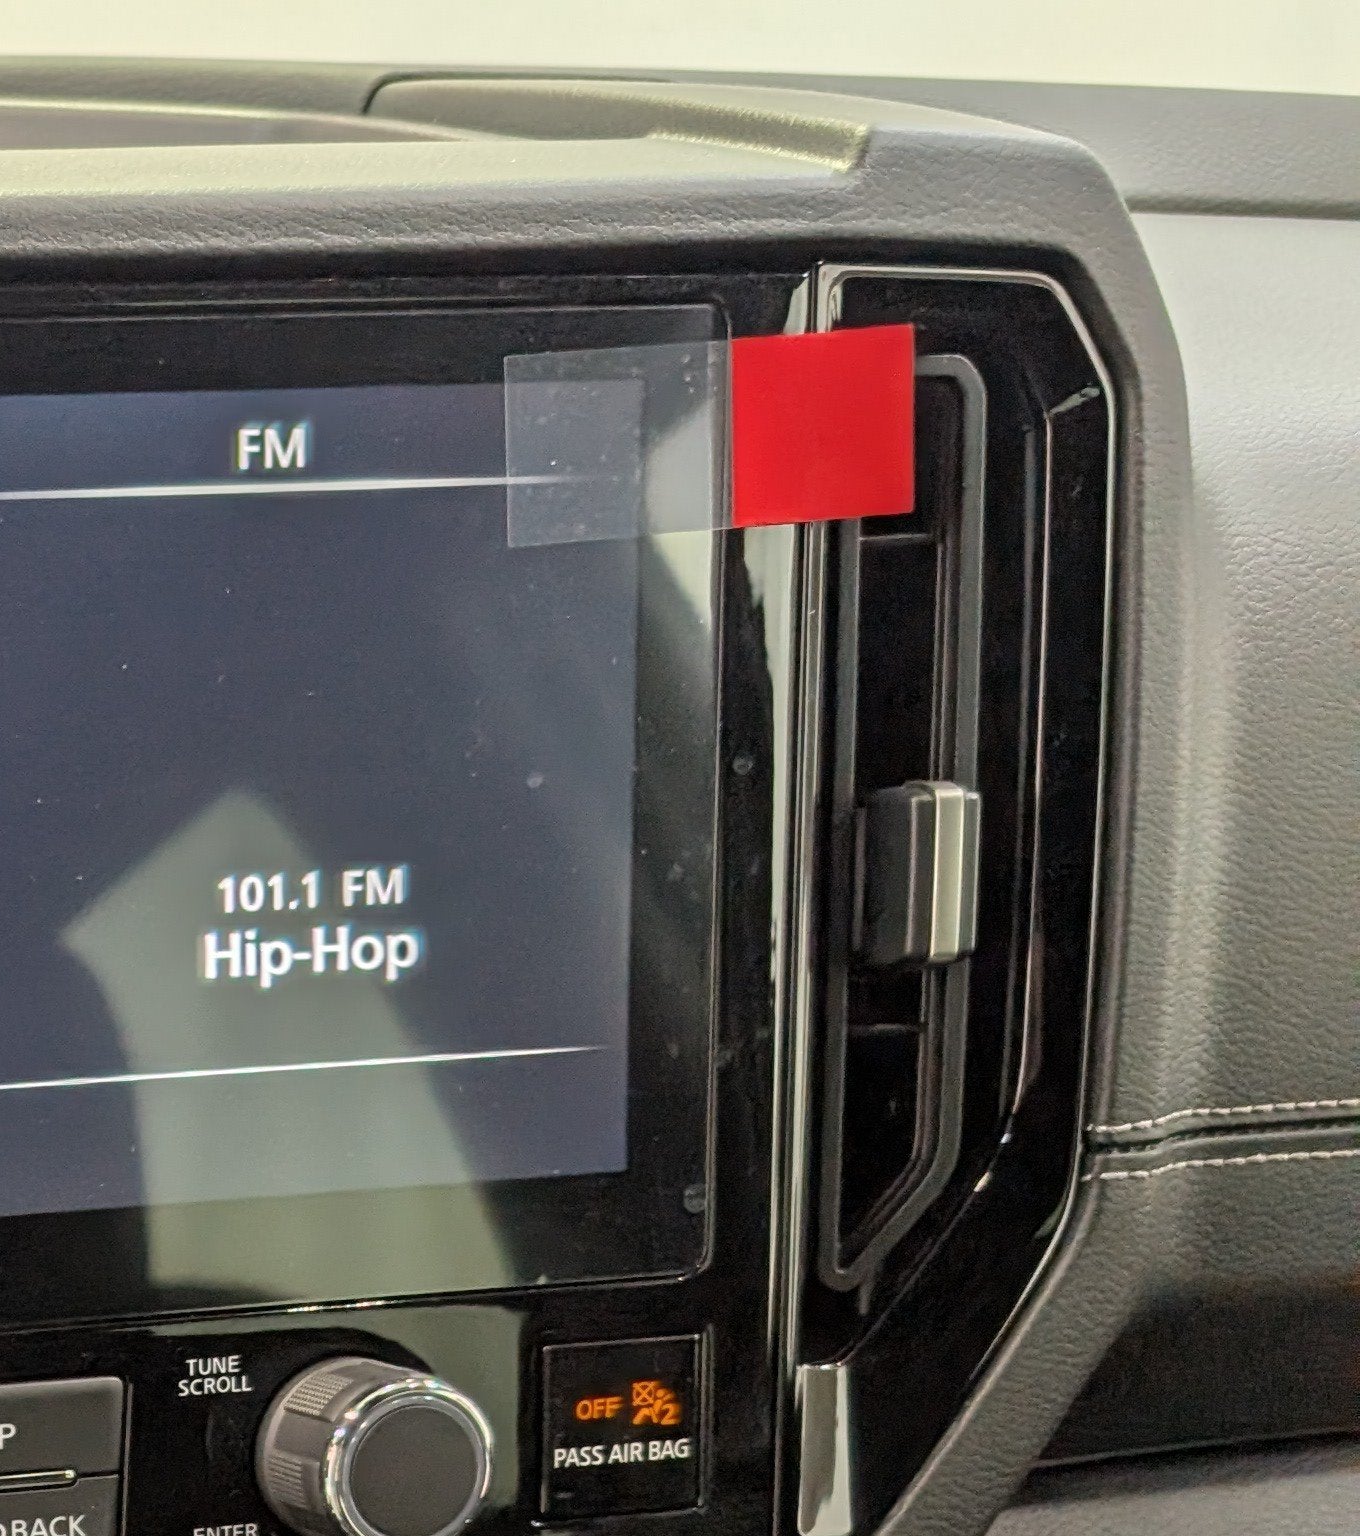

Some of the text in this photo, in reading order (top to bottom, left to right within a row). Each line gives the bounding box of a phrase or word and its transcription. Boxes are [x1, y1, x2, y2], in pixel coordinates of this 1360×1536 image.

[236, 425, 308, 471] FM
[217, 868, 406, 915] 101.1 FM
[200, 927, 420, 989] Hip-Hop
[186, 1355, 241, 1375] TUNE
[178, 1375, 252, 1397] SCROLL
[576, 1396, 623, 1420] OFF
[553, 1438, 690, 1469] PASS AIR BAG
